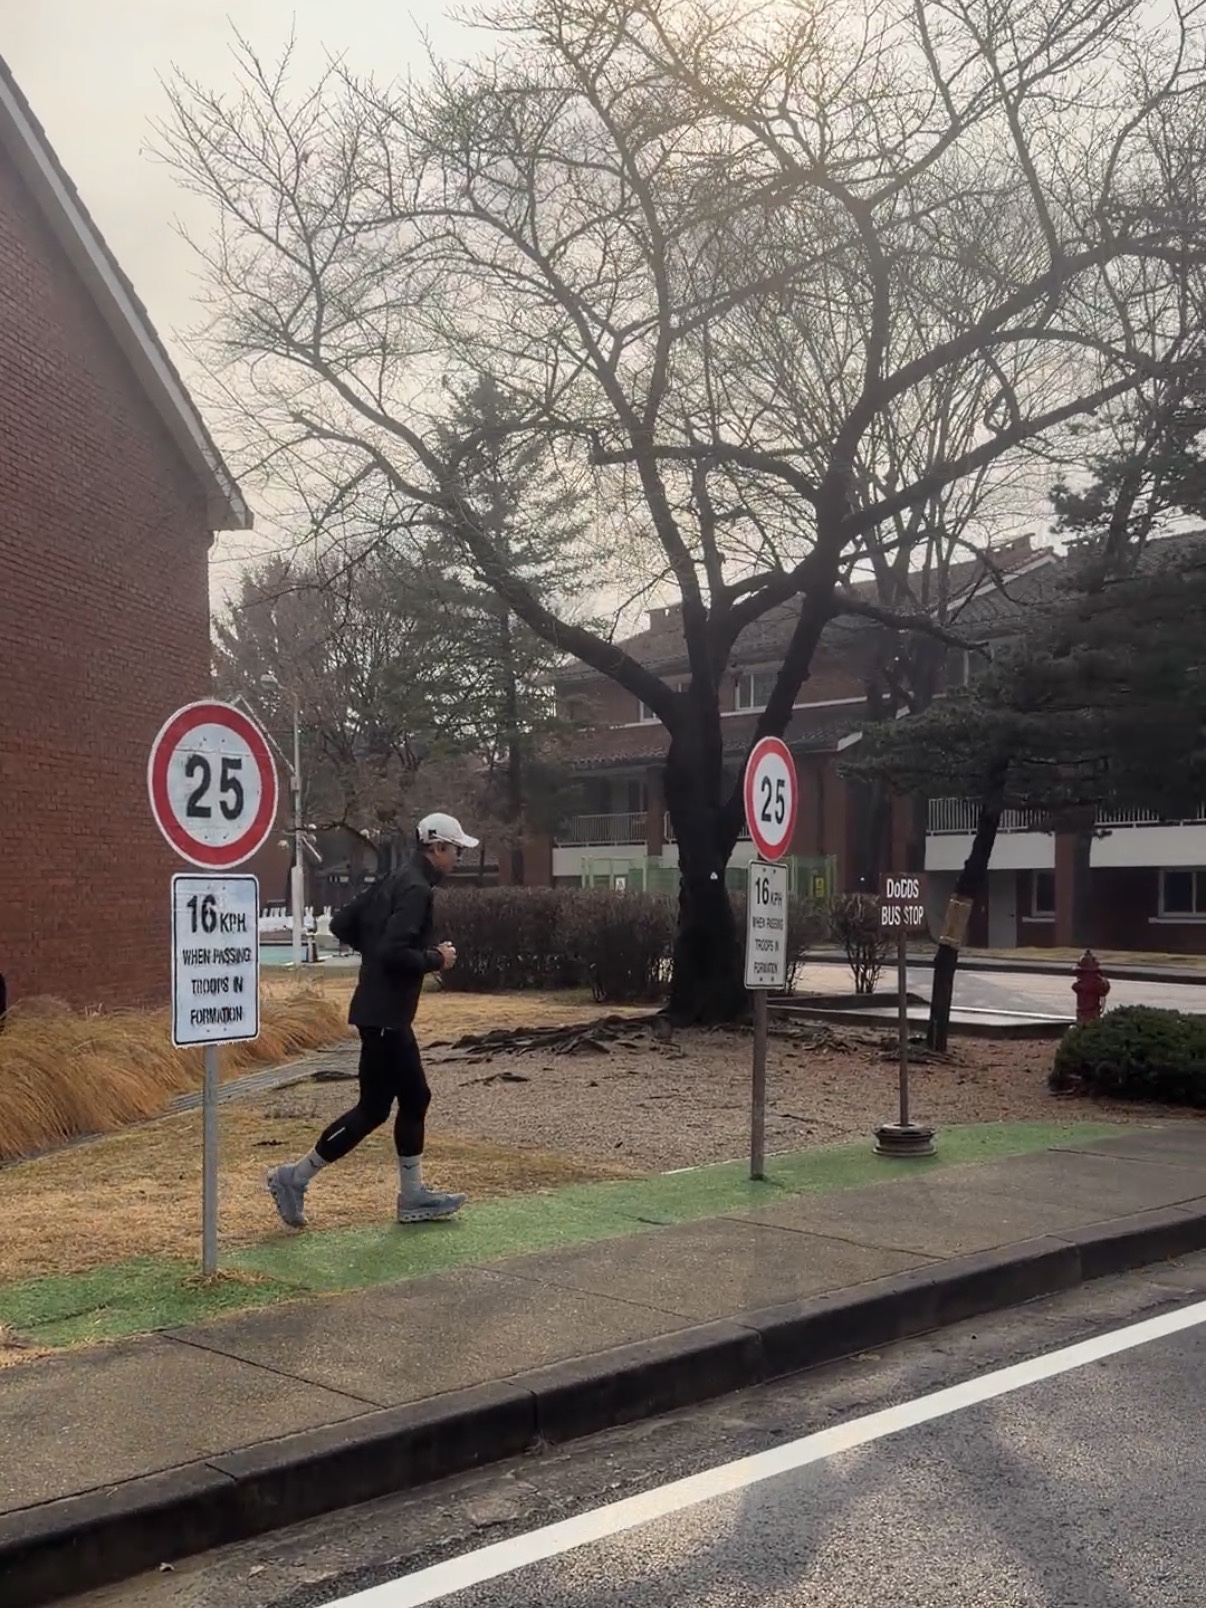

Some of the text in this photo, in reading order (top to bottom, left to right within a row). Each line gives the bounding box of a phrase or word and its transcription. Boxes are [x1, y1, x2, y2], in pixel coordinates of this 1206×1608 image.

[185, 754, 244, 820] 25
[761, 776, 785, 825] 25
[755, 877, 769, 905] 16
[187, 894, 247, 933] 16 KPH
[881, 905, 924, 925] BUS STOP
[182, 948, 251, 965] WHEN PASSING
[191, 976, 243, 995] TROOPS IN
[190, 1006, 243, 1026] FORMATION
